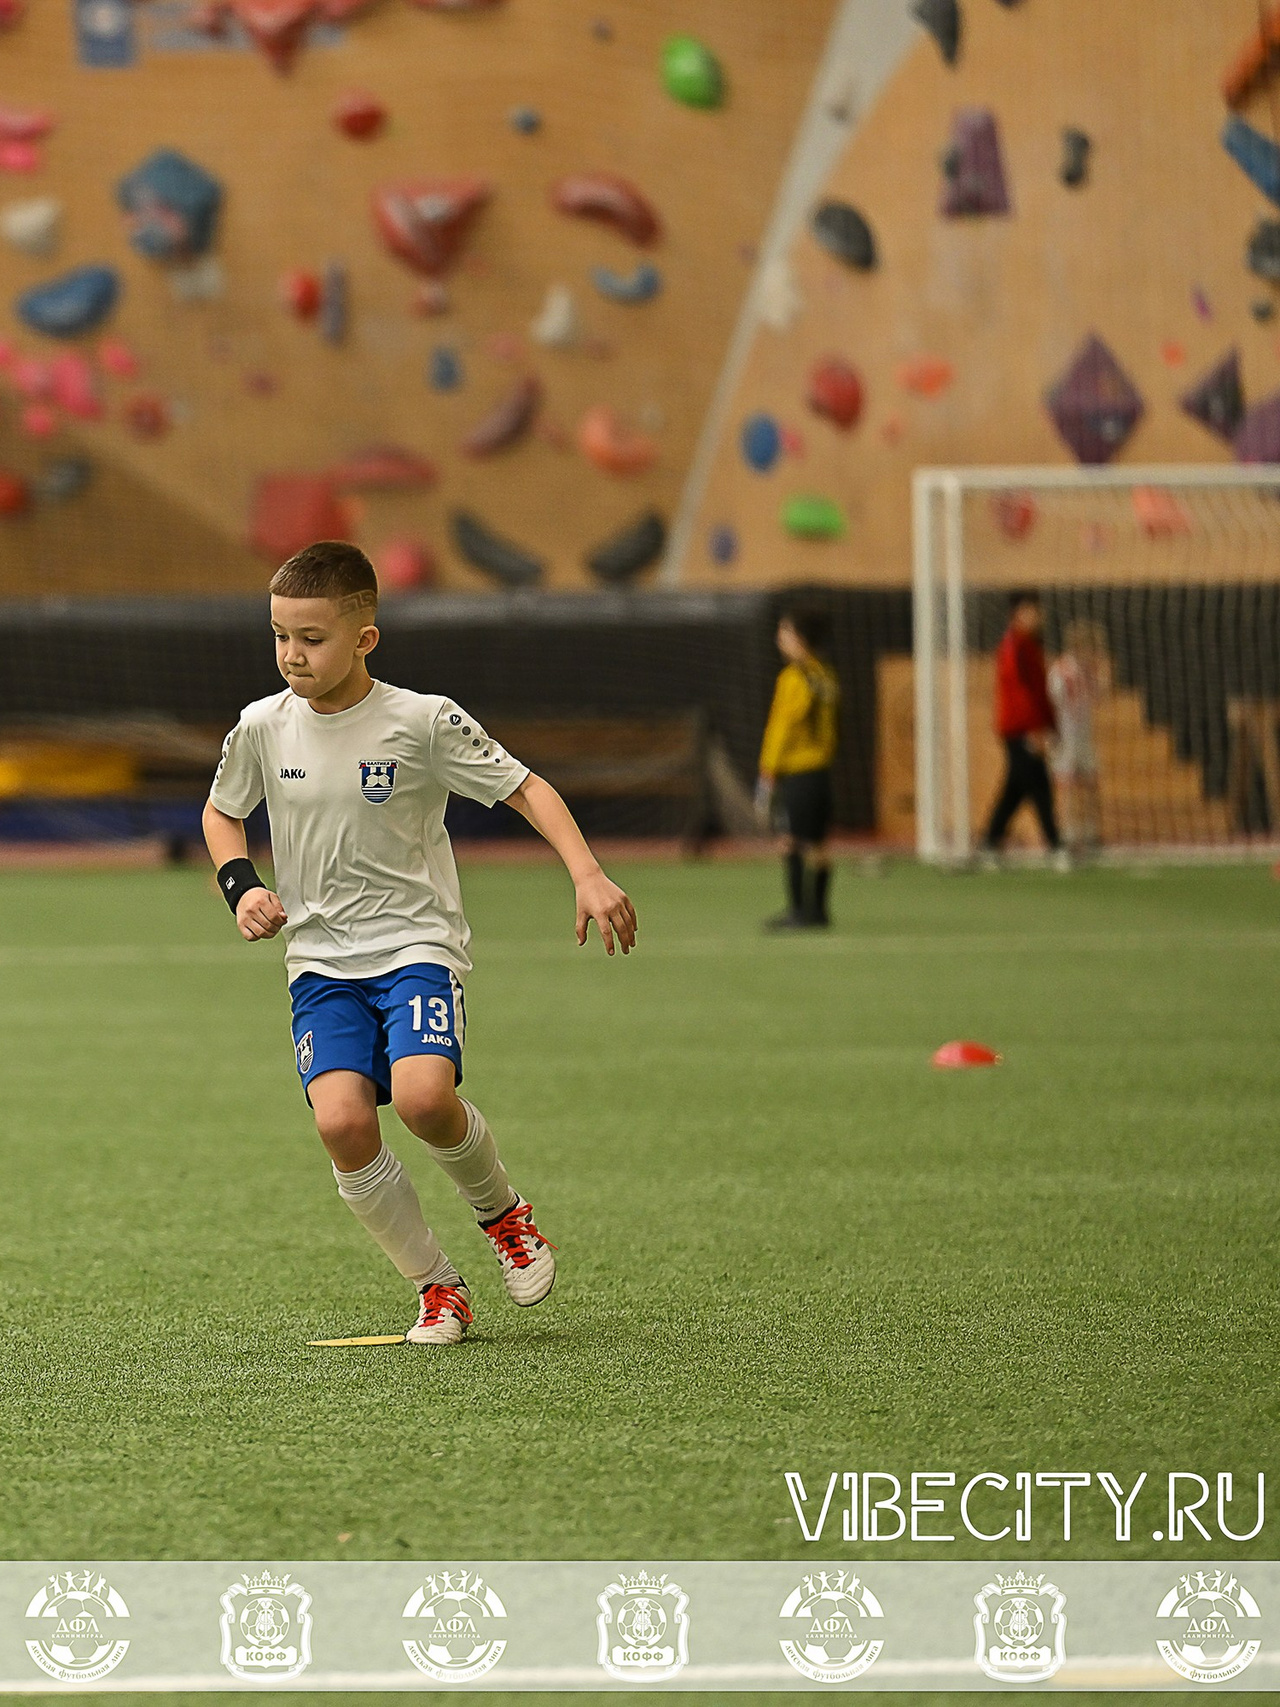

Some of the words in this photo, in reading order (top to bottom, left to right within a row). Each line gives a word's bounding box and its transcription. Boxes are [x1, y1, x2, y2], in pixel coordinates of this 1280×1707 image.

[280, 768, 306, 779] JAKO
[408, 995, 449, 1032] 13
[421, 1033, 453, 1047] JAKO
